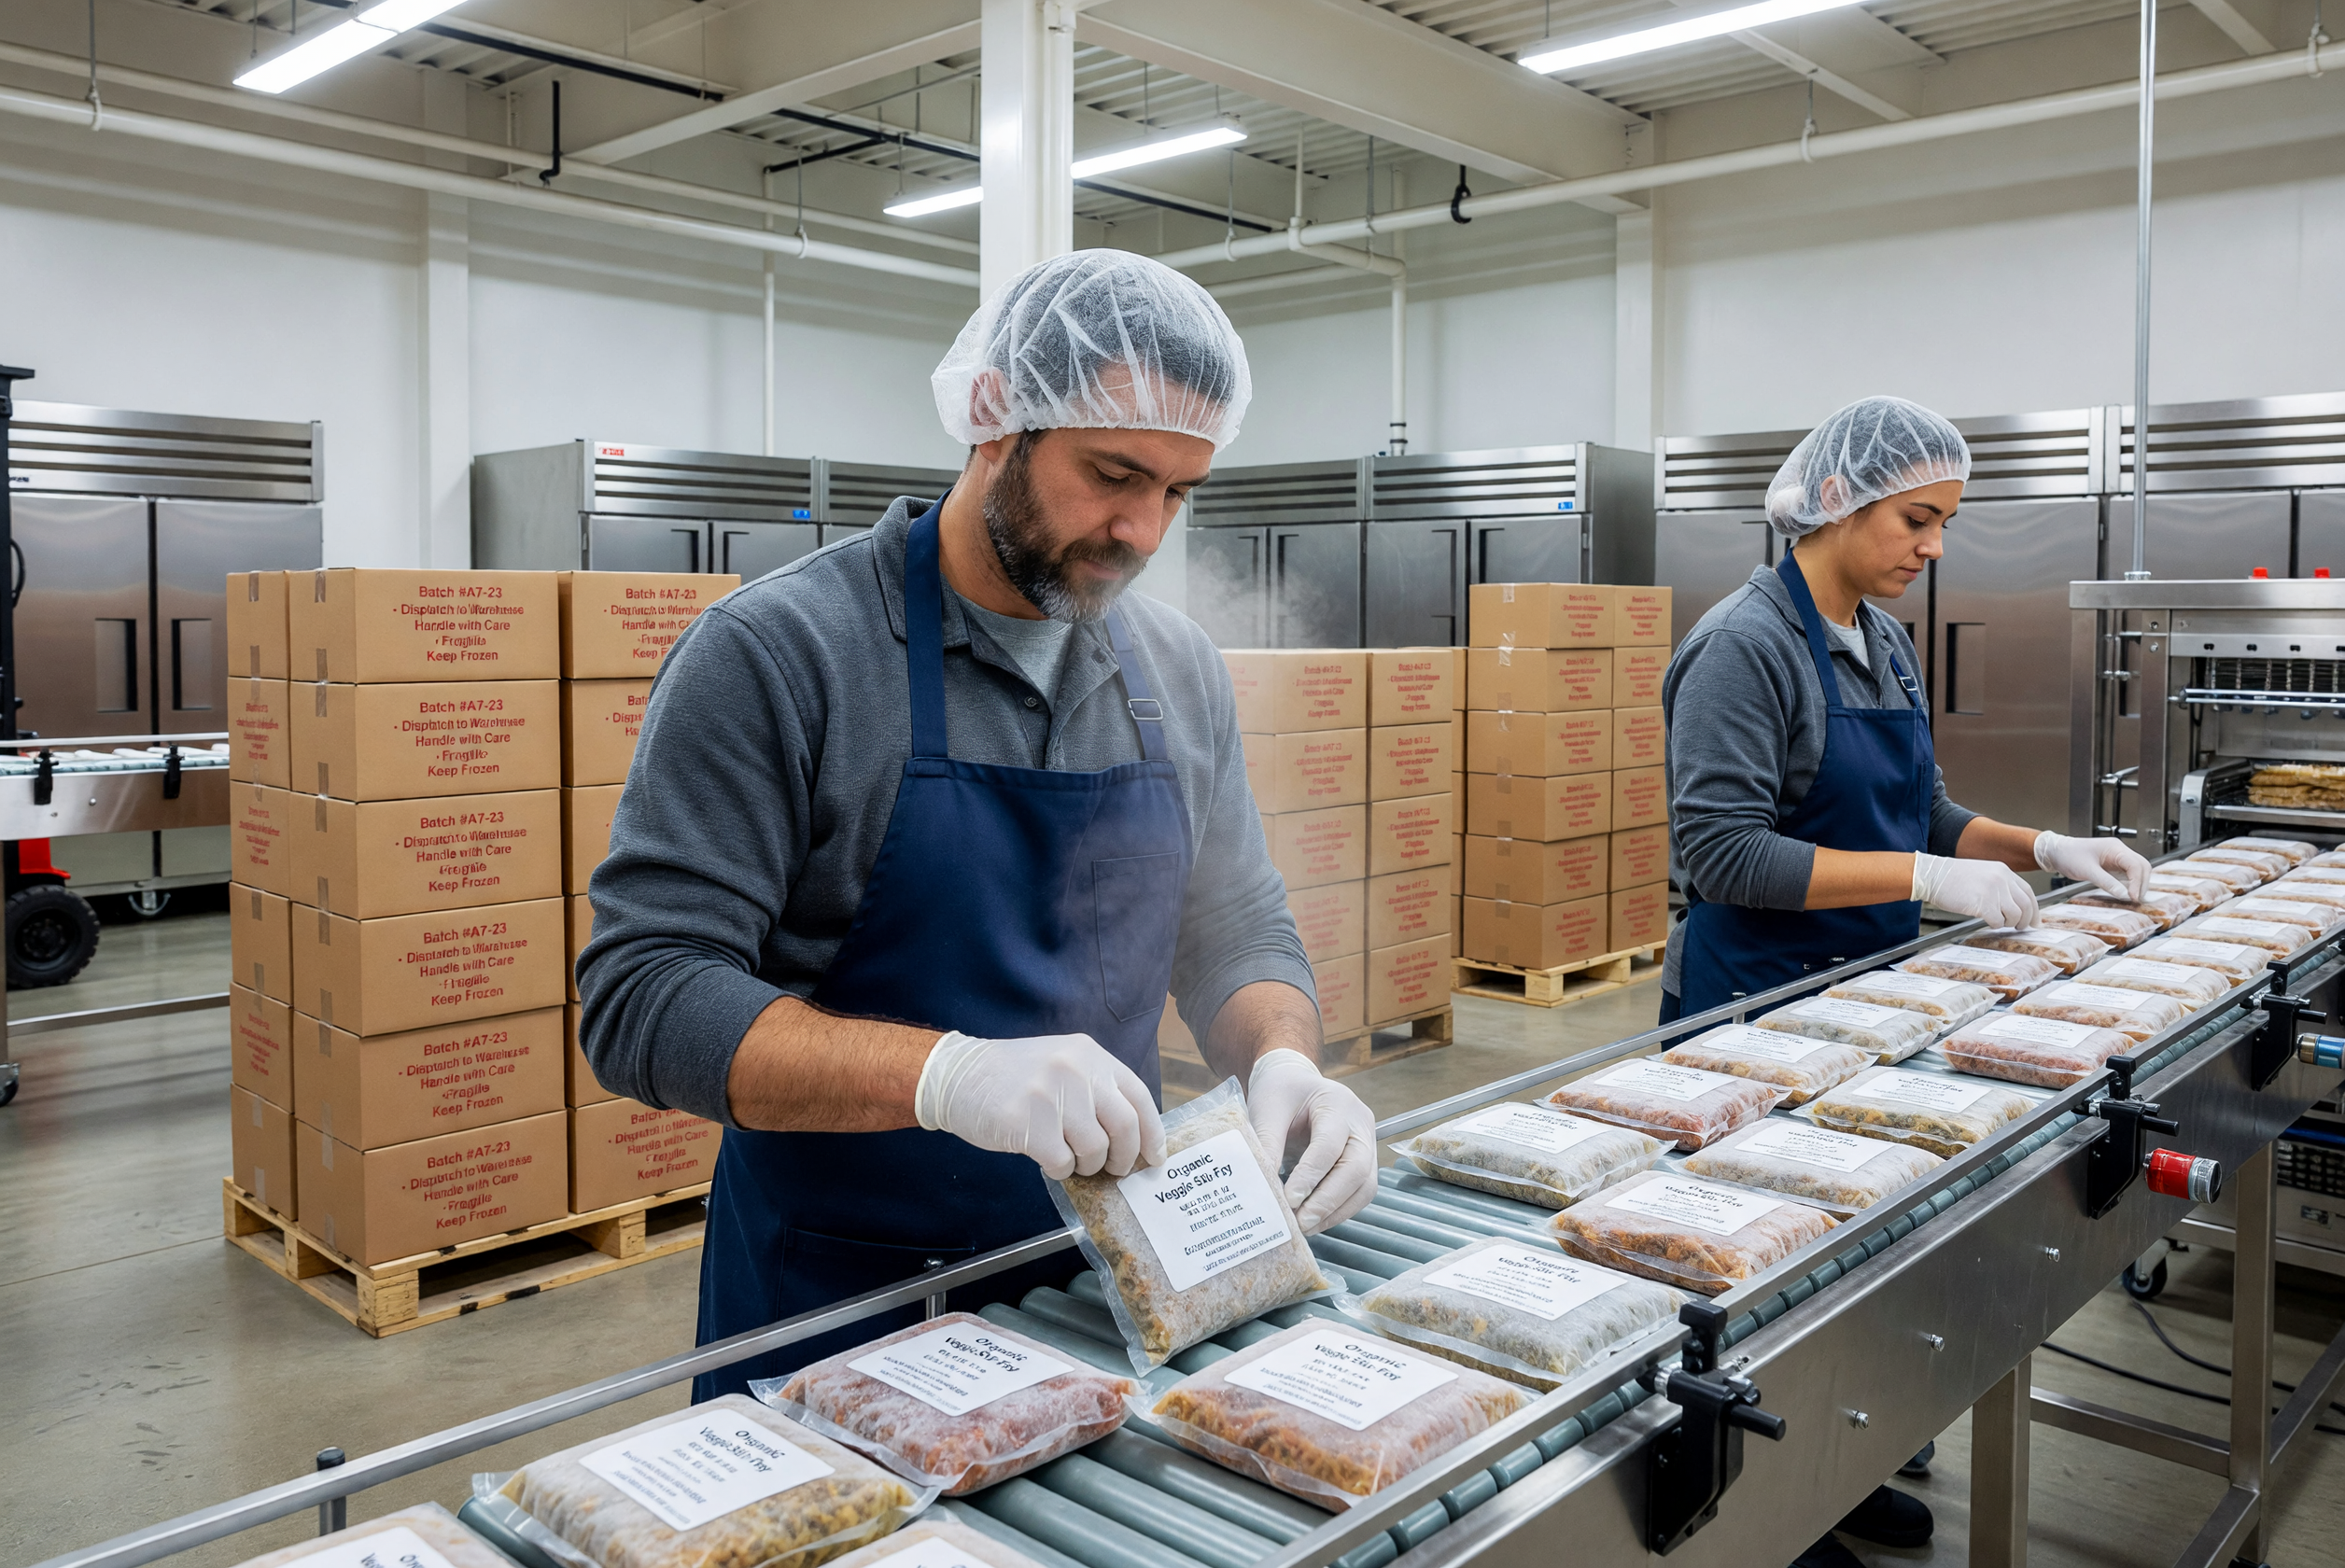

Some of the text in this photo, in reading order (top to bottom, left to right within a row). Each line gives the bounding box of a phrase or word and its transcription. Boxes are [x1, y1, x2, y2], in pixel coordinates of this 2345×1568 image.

[419, 586, 502, 597] Batch #A7-23
[626, 588, 655, 599] Batch
[484, 620, 510, 630] Care
[428, 651, 498, 663] Keep Frozen
[420, 699, 503, 713] Batch #A7-23
[628, 695, 649, 706] Bat
[415, 735, 455, 747] Handle
[484, 733, 511, 743] Care
[428, 764, 499, 777] Keep Frozen
[421, 816, 455, 829] Batch
[416, 848, 456, 862] Handle
[486, 845, 512, 855] Care
[429, 876, 499, 892] Keep Frozen
[424, 930, 458, 944] Batch
[420, 963, 459, 977] Handle
[488, 956, 514, 967] Care
[431, 987, 503, 1006] Keep Frozen
[424, 1031, 508, 1056] Batch #A7-23
[421, 1074, 459, 1089] Handle
[489, 1064, 515, 1076] Care
[432, 1096, 503, 1117] Keep Frozen
[428, 1141, 510, 1169] Batch #A7-23
[1168, 1155, 1213, 1179] Organic
[493, 1173, 518, 1185] Care
[436, 1206, 507, 1229] Keep Frozen
